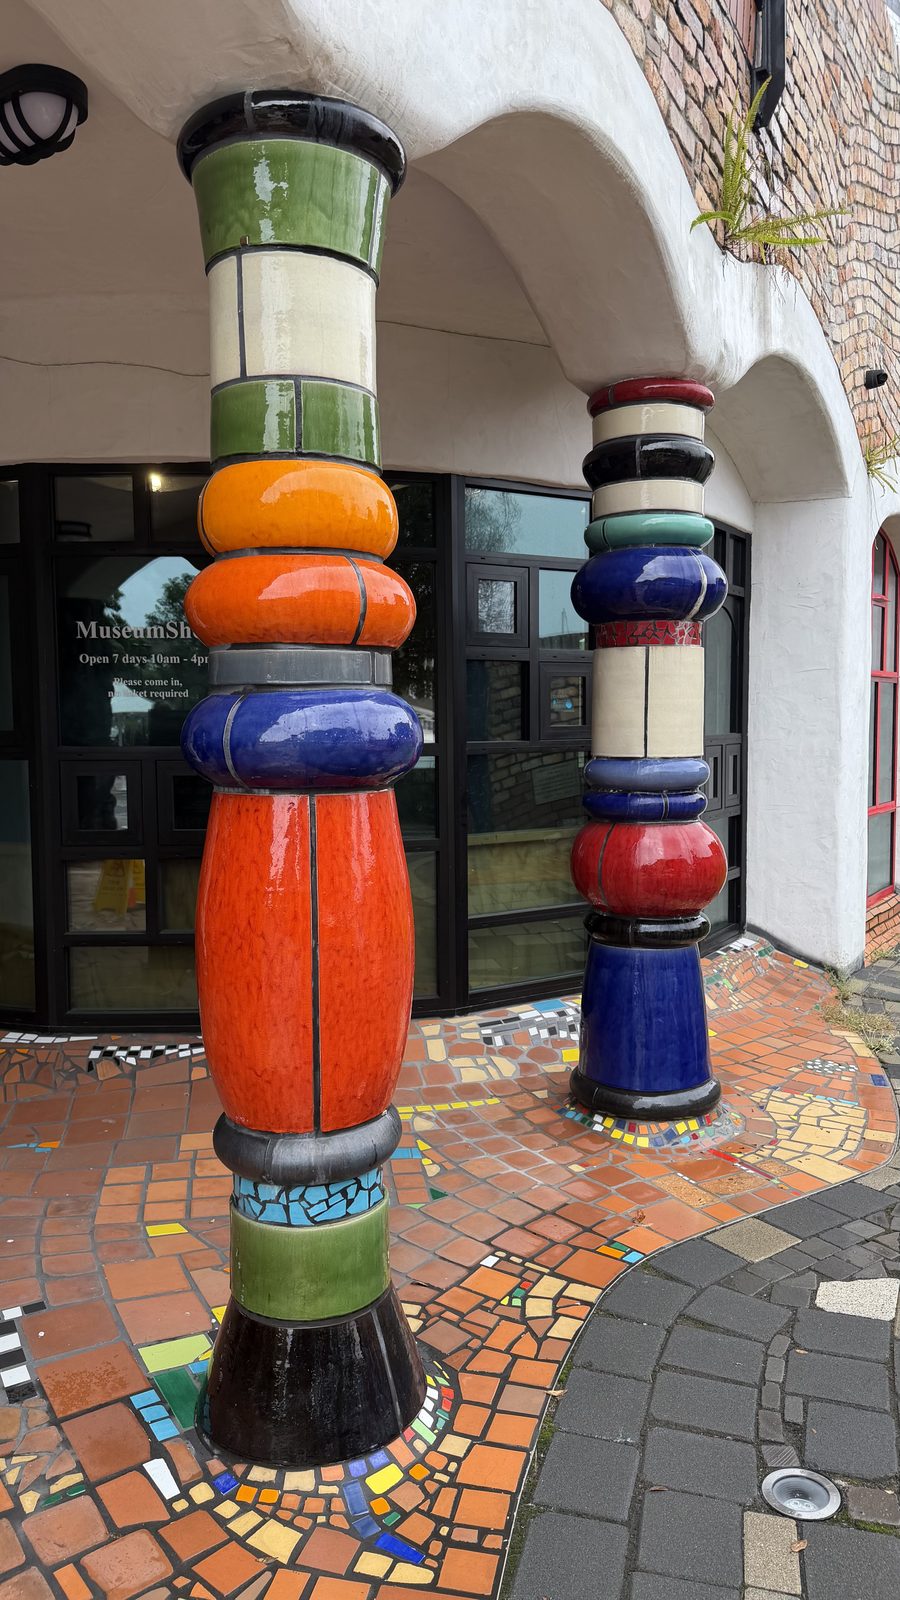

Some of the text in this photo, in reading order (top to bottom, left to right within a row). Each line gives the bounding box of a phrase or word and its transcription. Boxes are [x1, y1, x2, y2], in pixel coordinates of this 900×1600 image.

[79, 654, 109, 666] Open
[112, 654, 119, 663] 7
[122, 653, 147, 666] days
[151, 653, 180, 663] 10am
[113, 677, 142, 686] Please
[171, 677, 183, 687] in,
[150, 689, 189, 699] required
